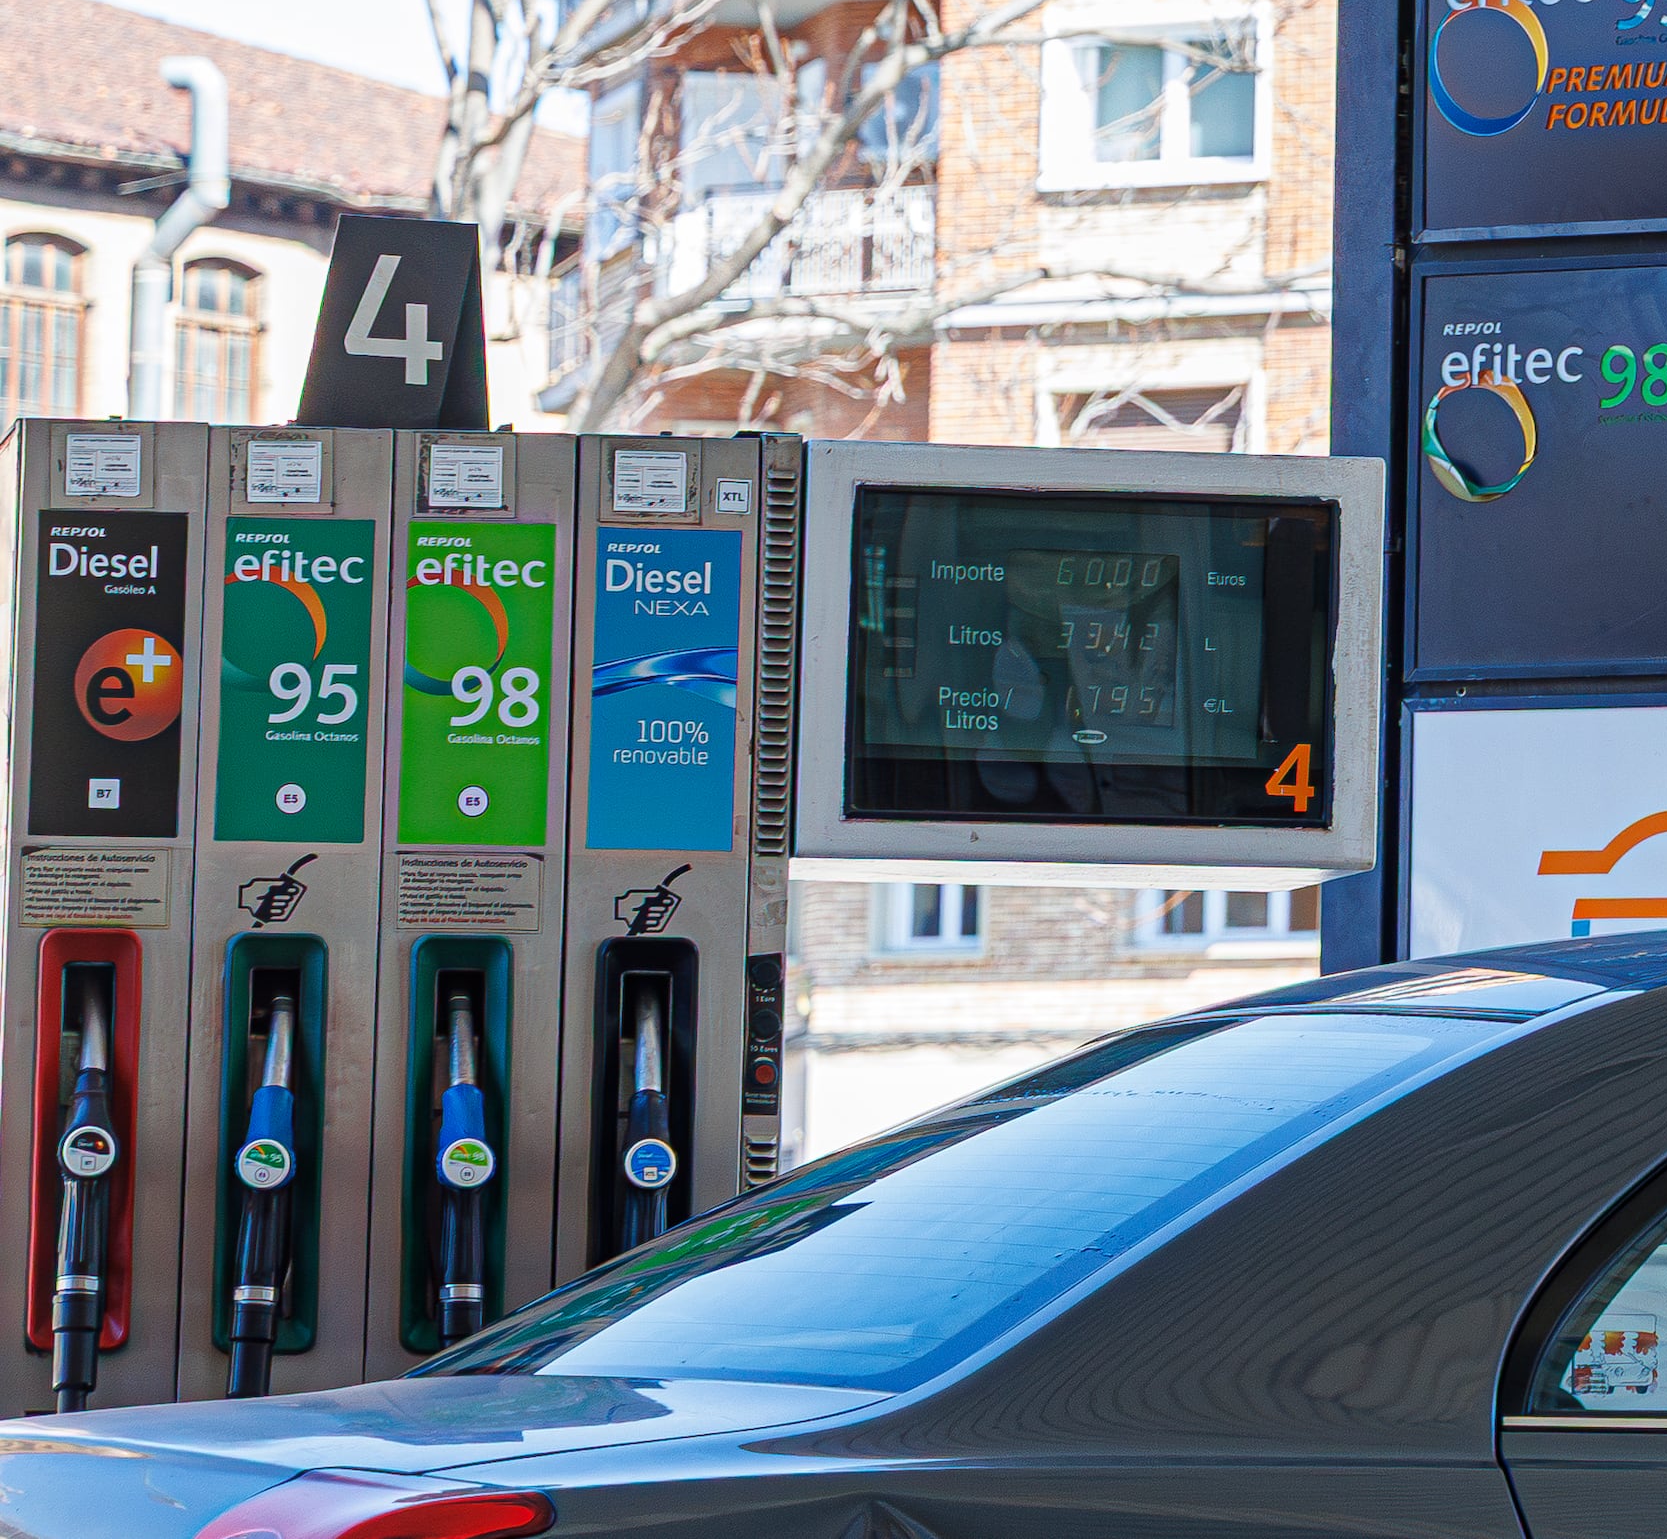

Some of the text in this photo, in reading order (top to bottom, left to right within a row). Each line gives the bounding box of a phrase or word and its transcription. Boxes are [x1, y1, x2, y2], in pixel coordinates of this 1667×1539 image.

[343, 254, 443, 385] 4
[1442, 322, 1502, 336] REPSOL
[1441, 342, 1584, 387] efitec
[721, 491, 746, 502] XTL
[50, 526, 107, 539] REPSOL
[235, 532, 291, 545] REPSOL
[417, 536, 473, 549] REPSOL
[607, 542, 662, 554] REPSOL
[48, 543, 158, 579] Diesel
[234, 550, 364, 584] efitec
[416, 553, 546, 588] efitec
[930, 559, 1005, 585] Importe
[605, 560, 712, 595] Diesel
[1207, 571, 1247, 587] Euros
[147, 585, 156, 595] A
[634, 599, 710, 617] NEXA
[949, 624, 1003, 647] Litros
[1204, 637, 1216, 651] L
[267, 662, 360, 724] 95
[449, 665, 540, 728] 98
[938, 686, 999, 709] Precio
[945, 709, 999, 731] Litros
[265, 729, 359, 743] Gasolina Octanos
[447, 733, 493, 746] Gasolina
[636, 719, 709, 746] 100%
[612, 745, 709, 766] renovable
[1265, 743, 1315, 812] 4
